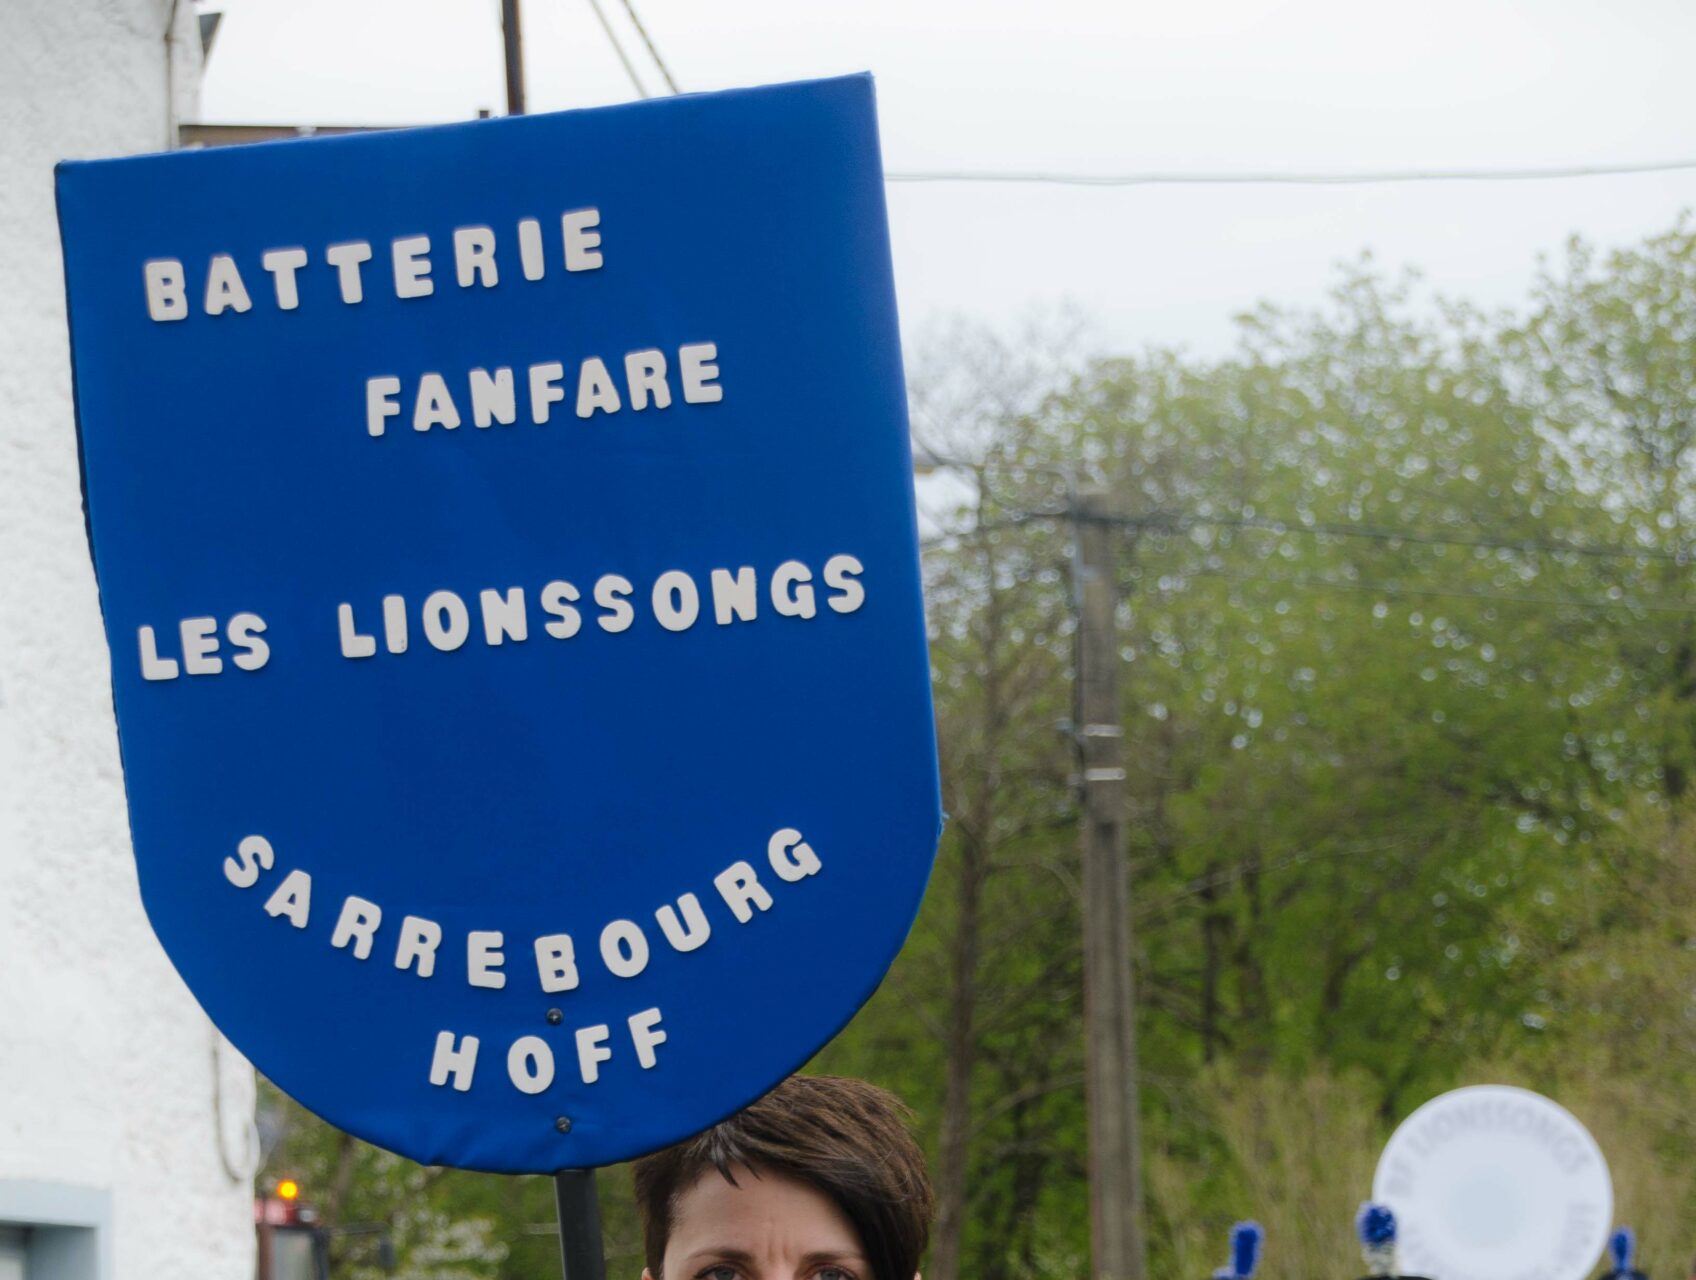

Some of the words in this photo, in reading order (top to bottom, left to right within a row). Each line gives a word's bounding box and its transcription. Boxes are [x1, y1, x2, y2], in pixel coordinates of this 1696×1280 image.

[144, 207, 603, 322] BATTERIE
[366, 342, 723, 437] FANFARE
[138, 612, 270, 681] LES
[338, 554, 865, 658] LIONSSONGS
[223, 828, 822, 993] SARREBOURG
[429, 1007, 667, 1095] HOFF
